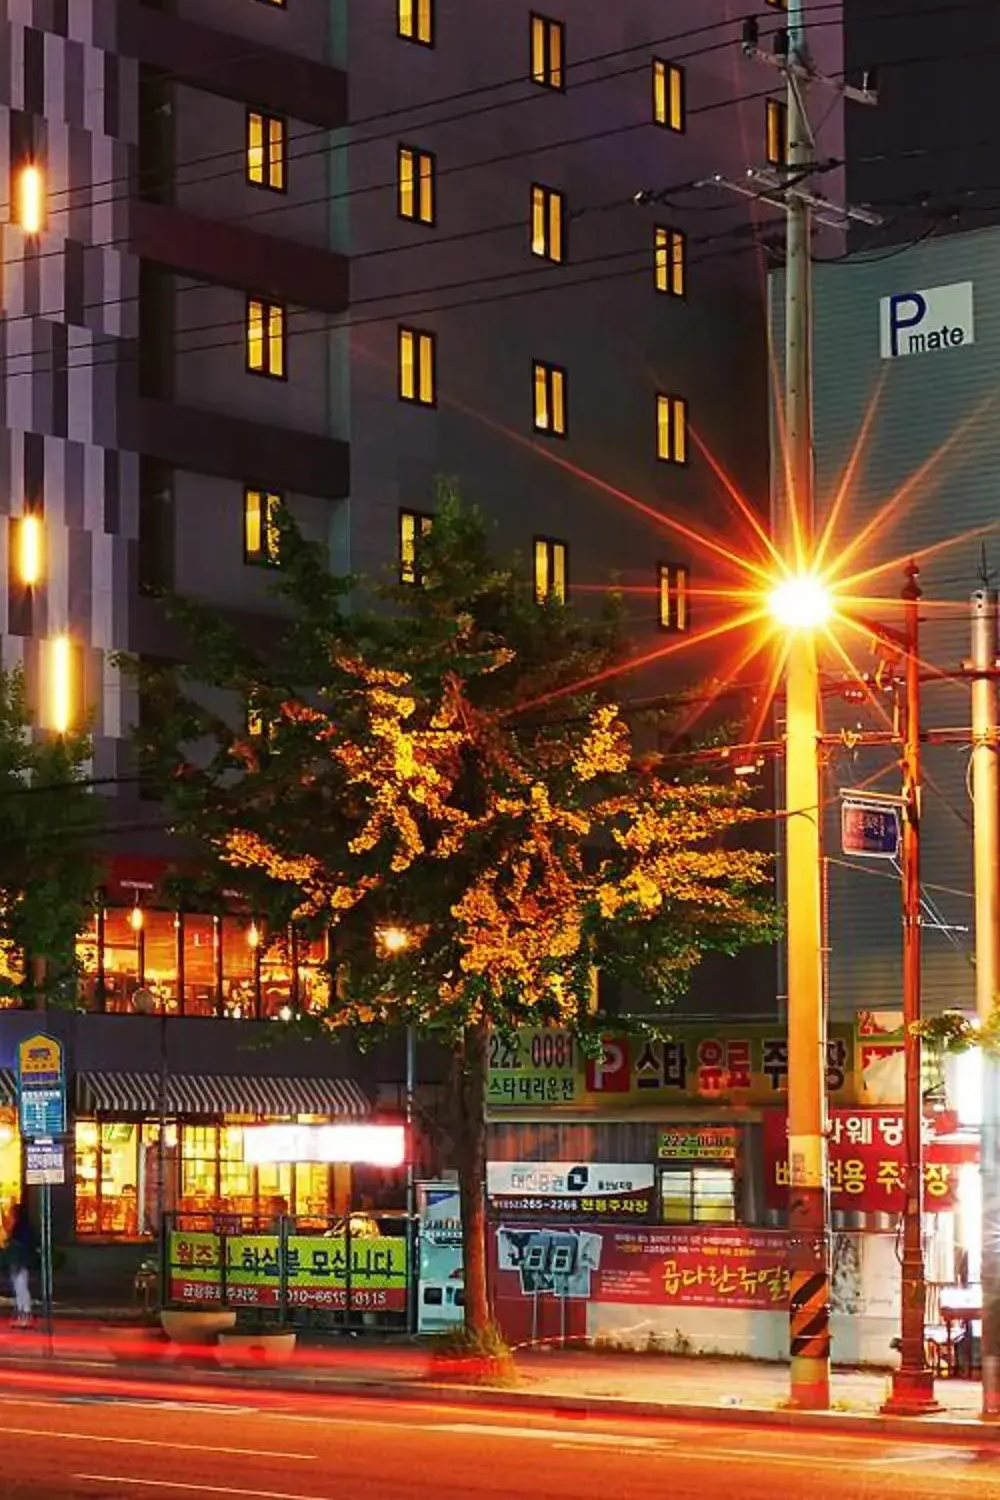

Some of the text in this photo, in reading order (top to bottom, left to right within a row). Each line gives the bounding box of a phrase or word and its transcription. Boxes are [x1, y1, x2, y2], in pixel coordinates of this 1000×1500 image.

[908, 326, 965, 353] mate
[635, 1041, 688, 1090] 스타
[762, 1038, 847, 1092] 주장
[876, 1160, 950, 1196] 주장
